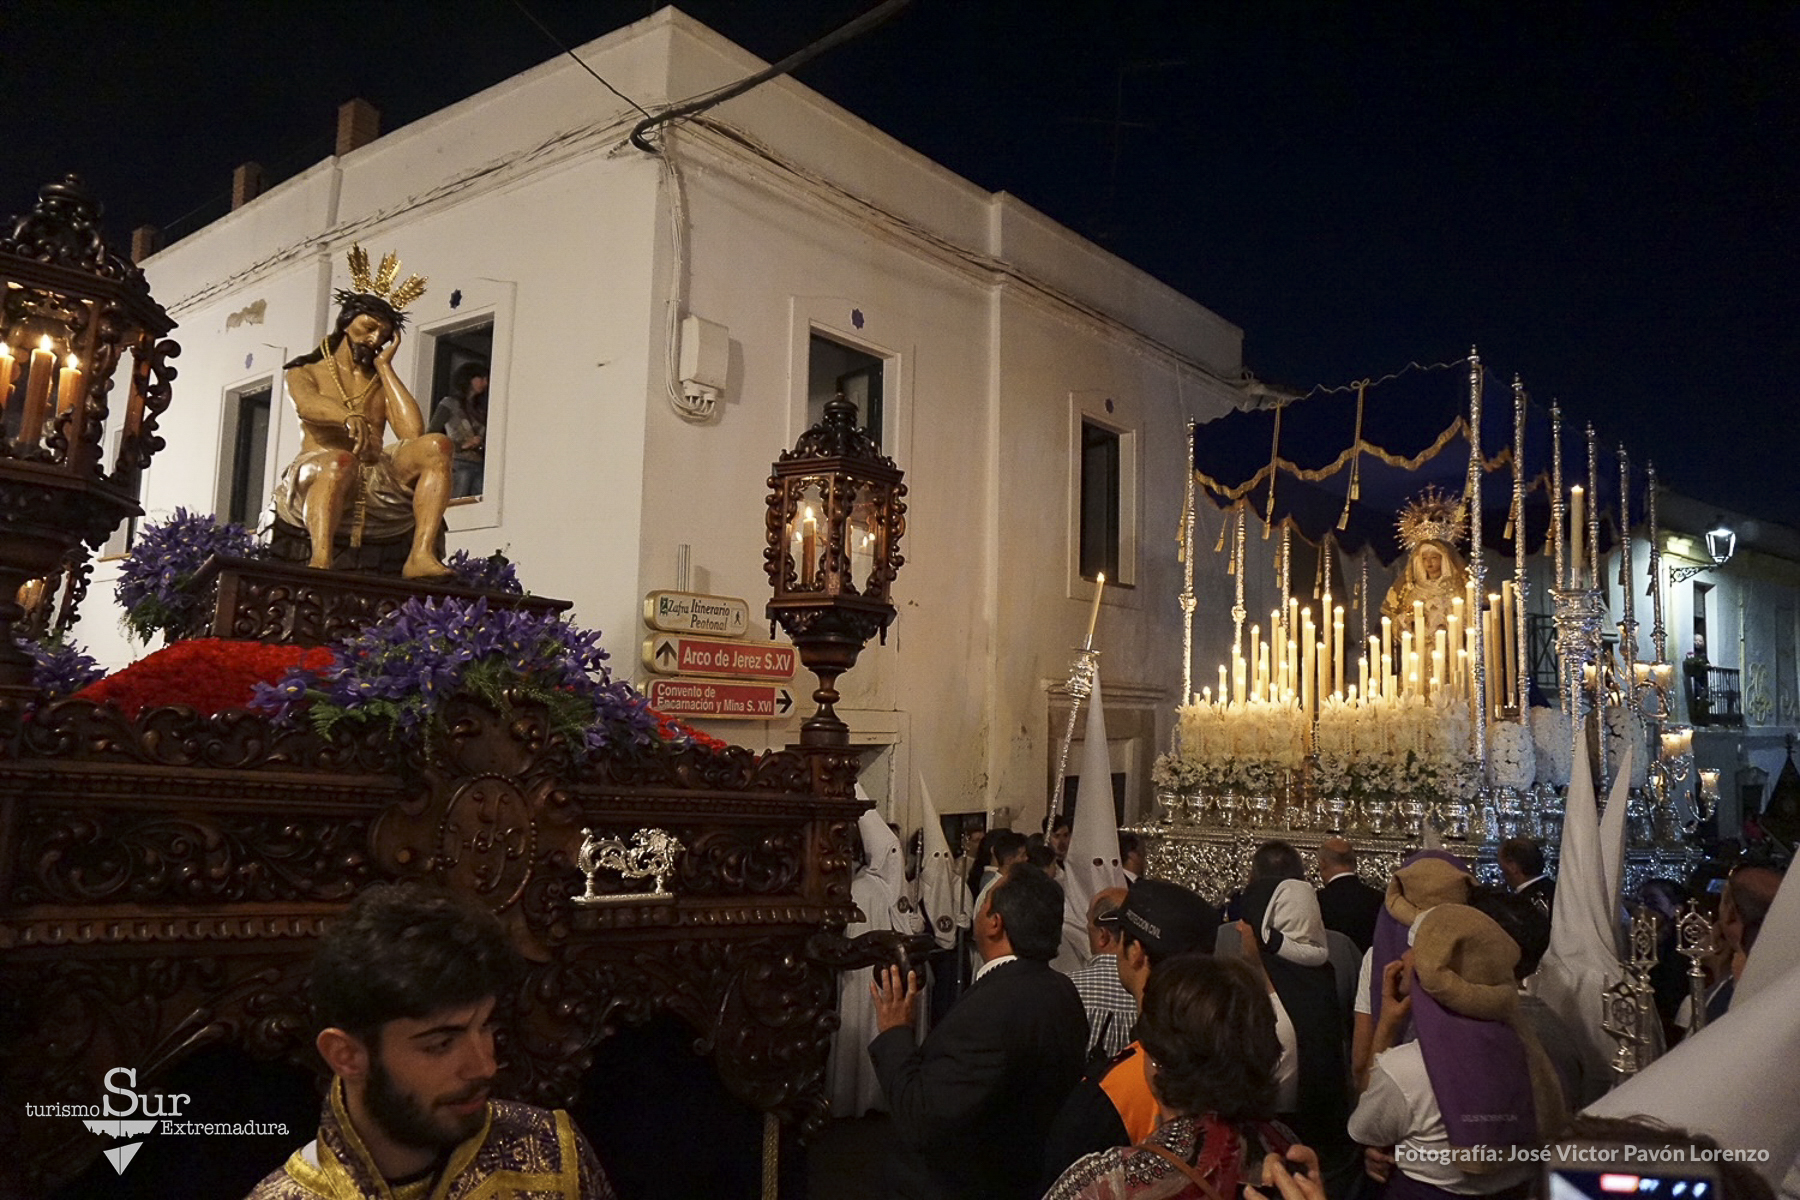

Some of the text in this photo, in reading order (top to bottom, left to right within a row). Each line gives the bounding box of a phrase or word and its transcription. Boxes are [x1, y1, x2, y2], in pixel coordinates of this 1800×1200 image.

[691, 599, 730, 616] Itinerario
[690, 614, 728, 630] Peatonal
[683, 647, 790, 671] Arco de Jerez S.XV
[657, 683, 716, 698] Convento de
[657, 697, 772, 714] Encarnación y Mina S. XVI
